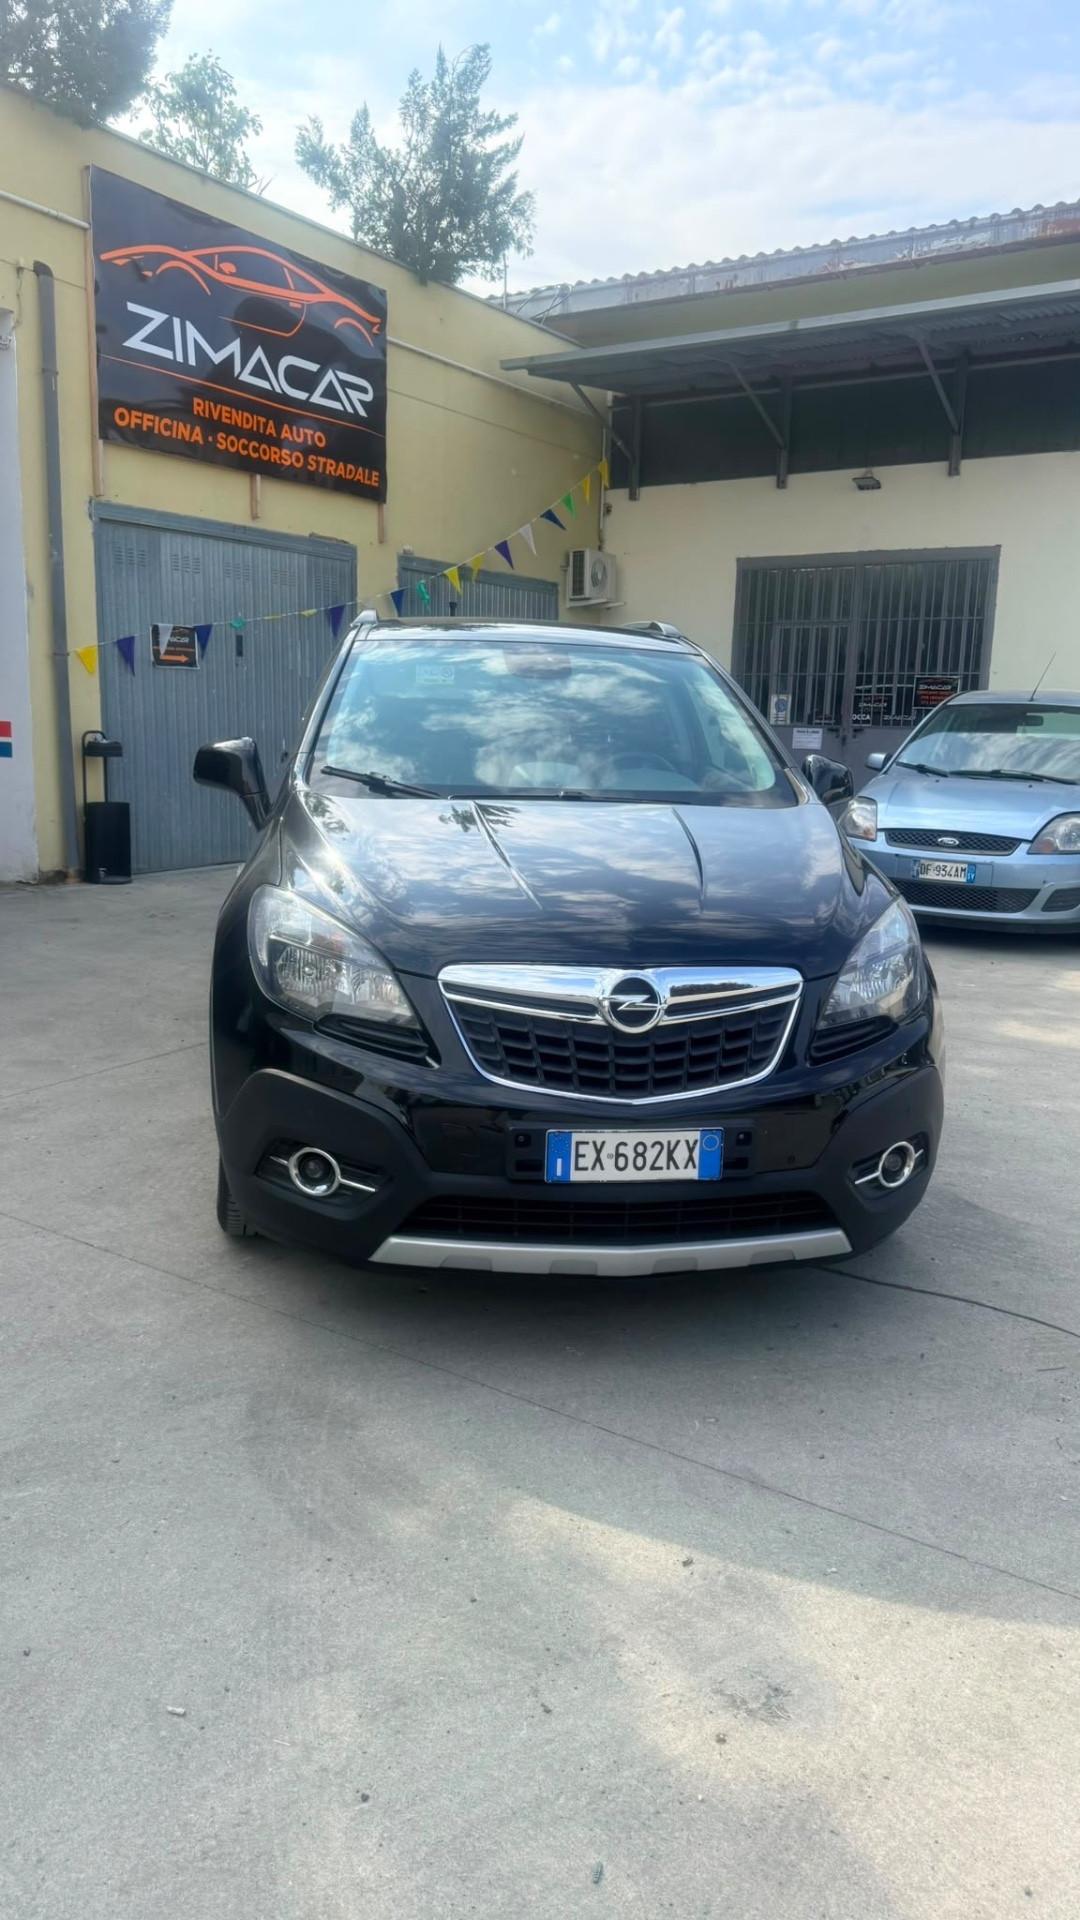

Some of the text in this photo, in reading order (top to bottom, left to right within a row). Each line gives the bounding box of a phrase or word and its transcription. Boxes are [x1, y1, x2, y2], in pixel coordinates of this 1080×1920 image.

[122, 301, 374, 418] ZIMACAR
[114, 407, 380, 487] OFFICINA SOCCORSO STRADALE
[193, 397, 326, 448] RIVENDITA AUTO
